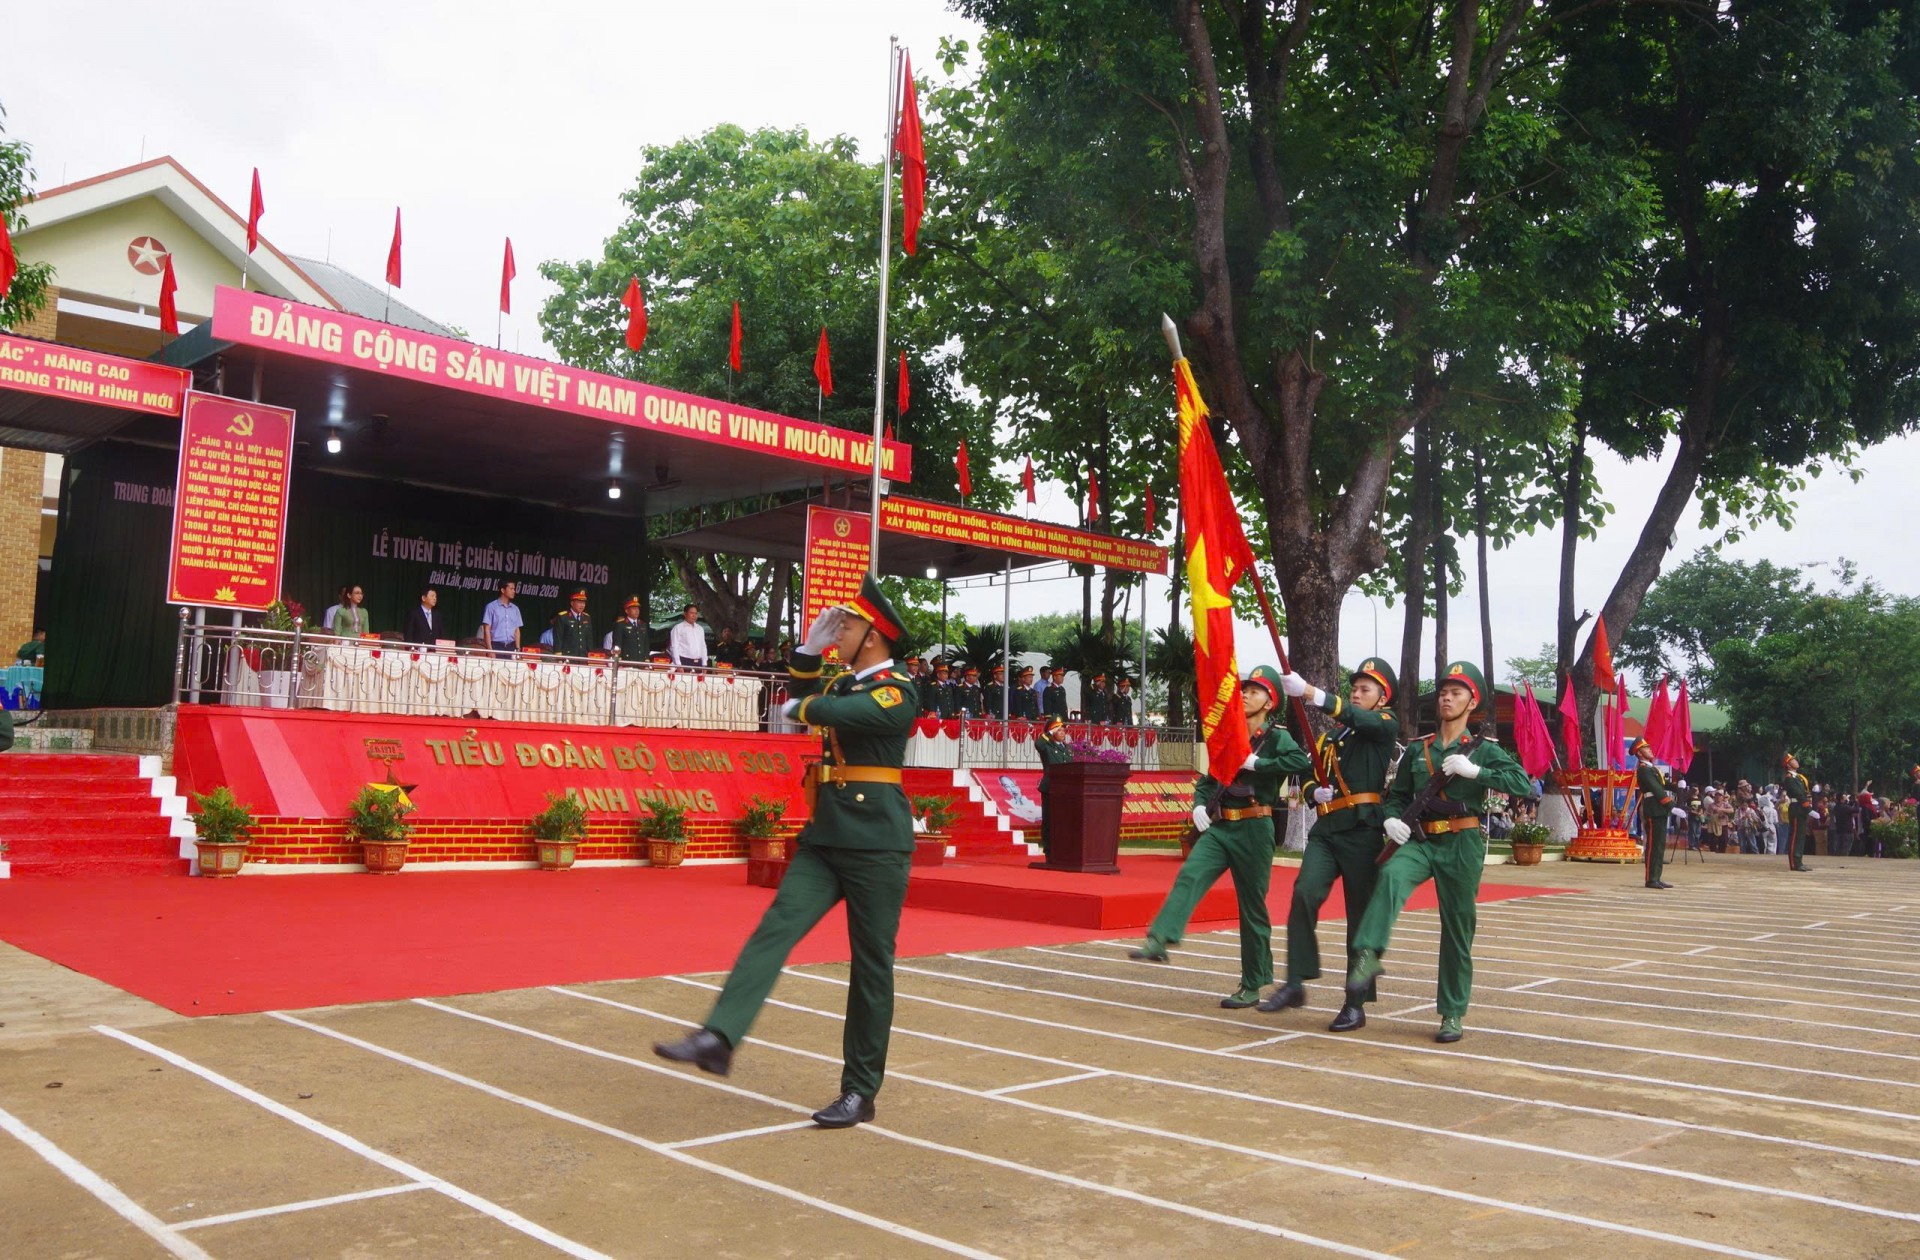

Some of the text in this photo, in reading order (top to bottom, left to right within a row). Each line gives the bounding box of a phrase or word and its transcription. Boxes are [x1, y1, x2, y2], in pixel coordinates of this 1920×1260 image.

[44, 353, 92, 375] NÂNG
[97, 363, 130, 381] CAO
[56, 375, 94, 395] TÌNH
[99, 384, 139, 403] HÌNH
[142, 392, 173, 409] MỚI
[250, 304, 895, 471] ĐẢNG CỘNG SẢN VIỆT NAM QUANG VINH MUÔN NĂM
[224, 440, 232, 449] TA
[189, 459, 198, 468] VÀ
[114, 481, 176, 507] TRUNG ĐOÀ
[184, 520, 208, 532] TRONG
[881, 501, 905, 514] PHÁT
[907, 506, 924, 517] HUY
[1035, 528, 1046, 538] TÀI
[1093, 540, 1112, 550] DANH
[886, 516, 903, 528] XÂY
[906, 520, 930, 532] DỰNG
[932, 524, 945, 534] CƠ
[946, 526, 971, 539] QUAN,
[991, 534, 1000, 546] VỊ
[1024, 540, 1046, 552] MẠNH
[1048, 544, 1067, 555] TOÀN
[372, 527, 608, 585] LỄ TUYÊN THỆ CHIẾN SĨ MỚI NĂM 2026
[462, 575, 482, 590] ngày
[483, 578, 492, 590] 10
[522, 583, 539, 596] năm
[539, 584, 559, 598] 2026
[425, 728, 791, 776] TIỂU ĐOÀN BỘ BINH 303
[565, 782, 719, 813] ANH HÙNG
